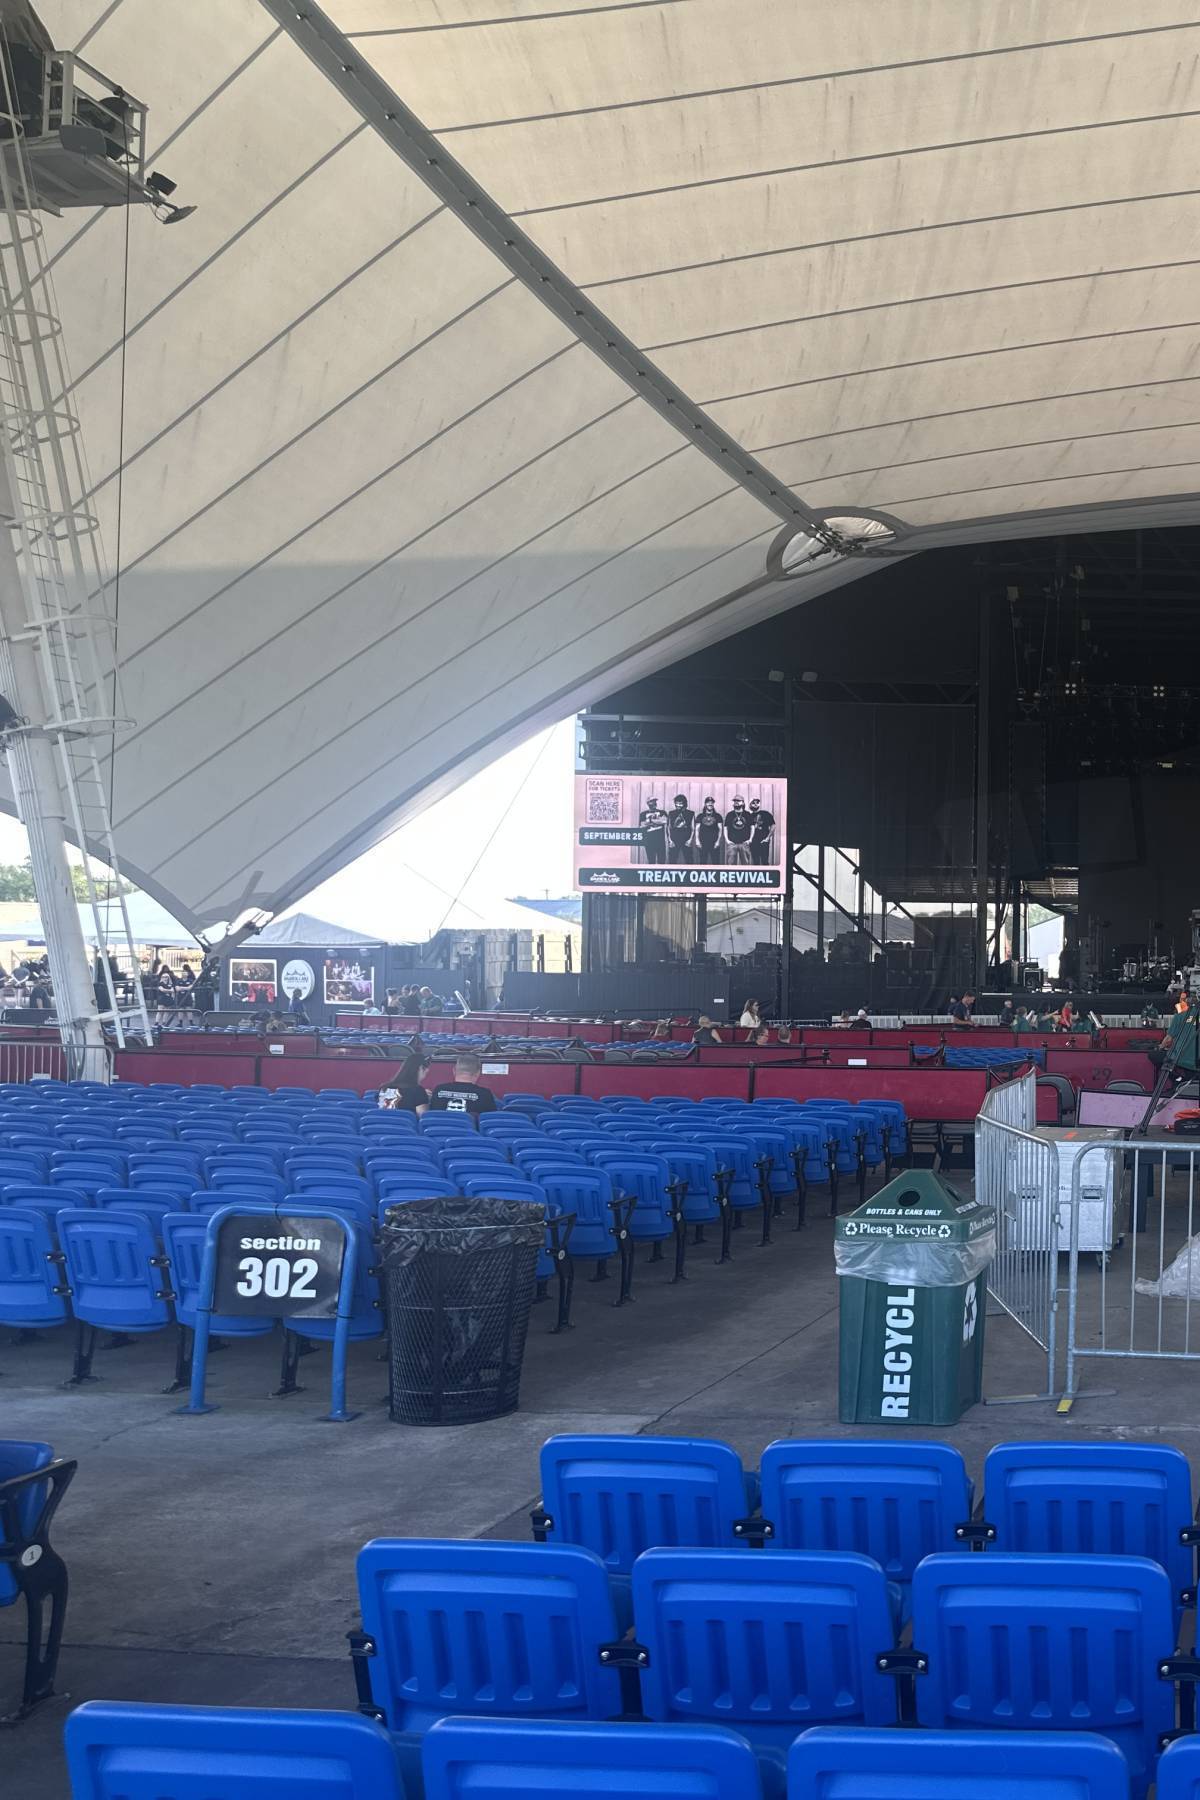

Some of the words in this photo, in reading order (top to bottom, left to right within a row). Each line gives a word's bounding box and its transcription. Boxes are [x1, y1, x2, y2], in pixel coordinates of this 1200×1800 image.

[584, 832, 631, 840] SEPTEMBER
[632, 832, 643, 840] 25
[637, 870, 687, 882] TREATY
[689, 871, 716, 883] OAK
[719, 872, 773, 884] REVIVAL
[859, 1223, 893, 1234] Please
[896, 1224, 937, 1237] Recycle
[240, 1236, 321, 1251] section
[237, 1256, 319, 1298] 302
